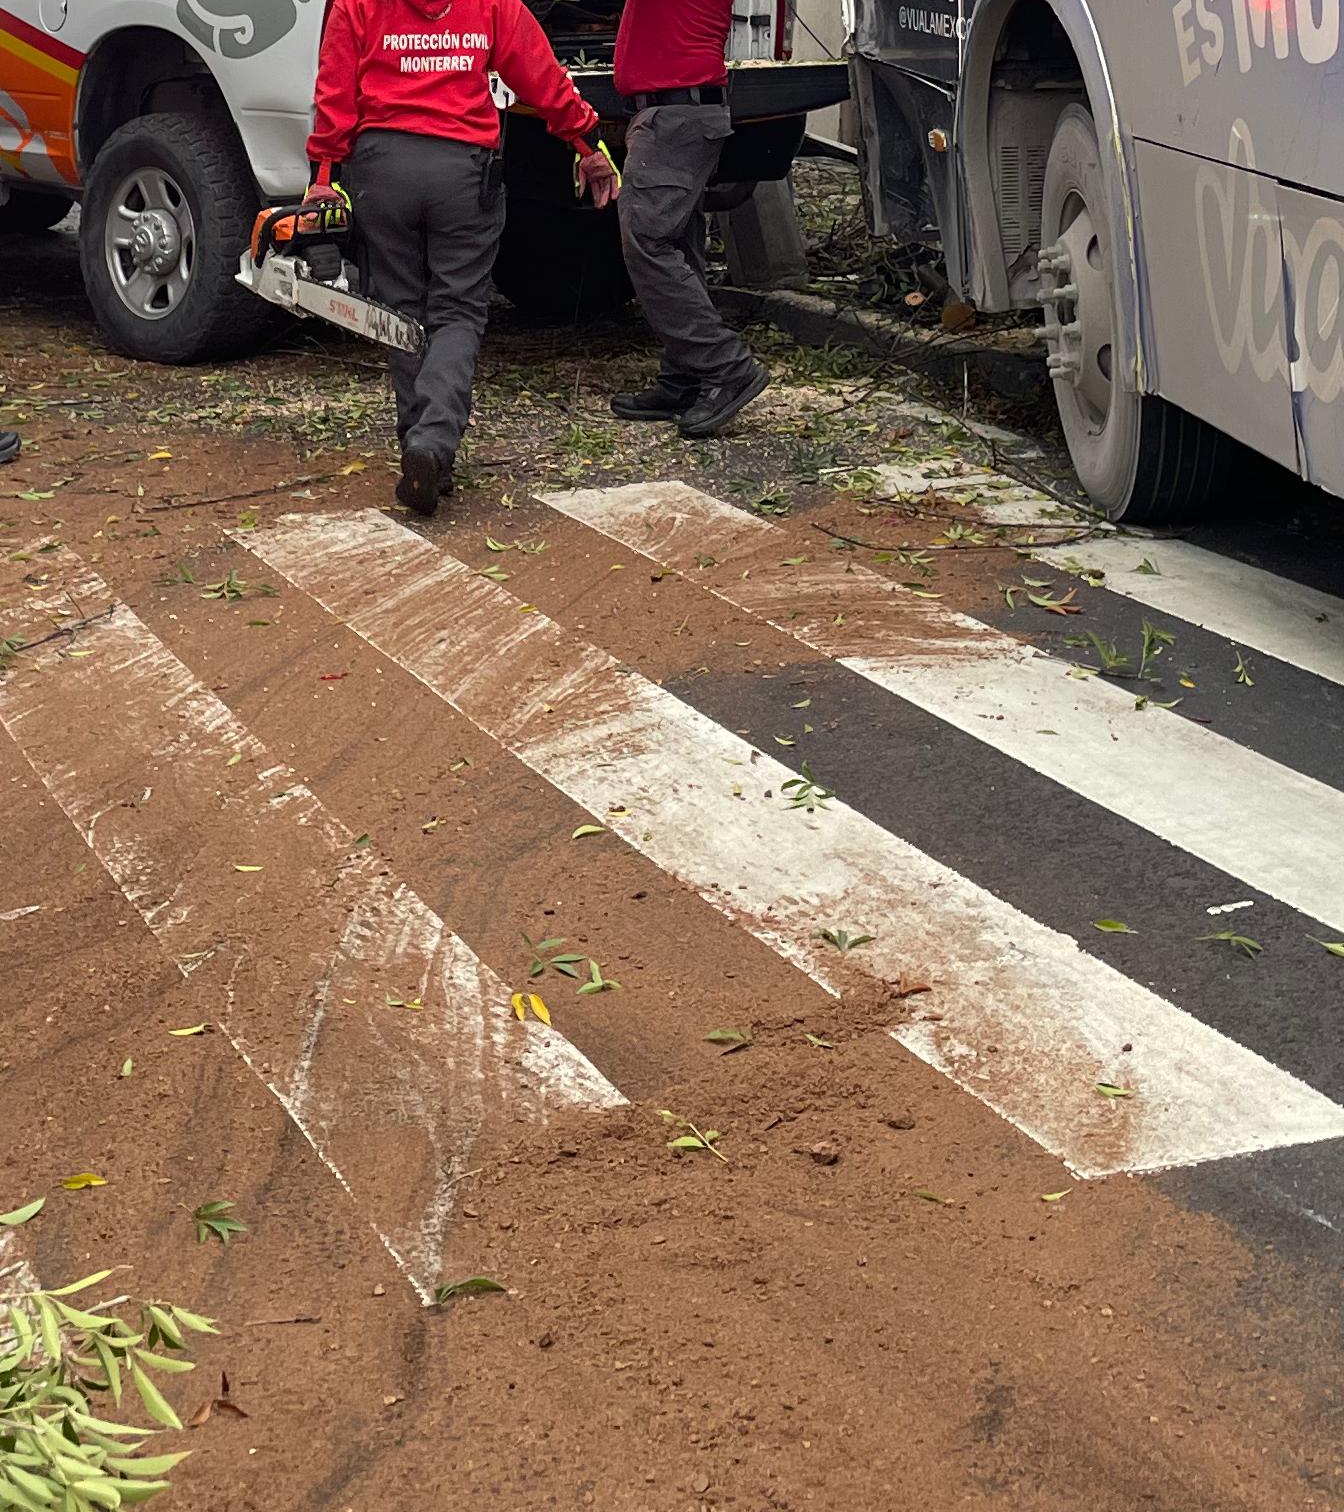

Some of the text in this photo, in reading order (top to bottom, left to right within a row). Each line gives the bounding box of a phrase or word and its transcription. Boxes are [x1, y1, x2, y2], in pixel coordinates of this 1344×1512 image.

[383, 29, 489, 51] PROTECCIÓN CIVIL
[400, 55, 475, 73] MONTERREY
